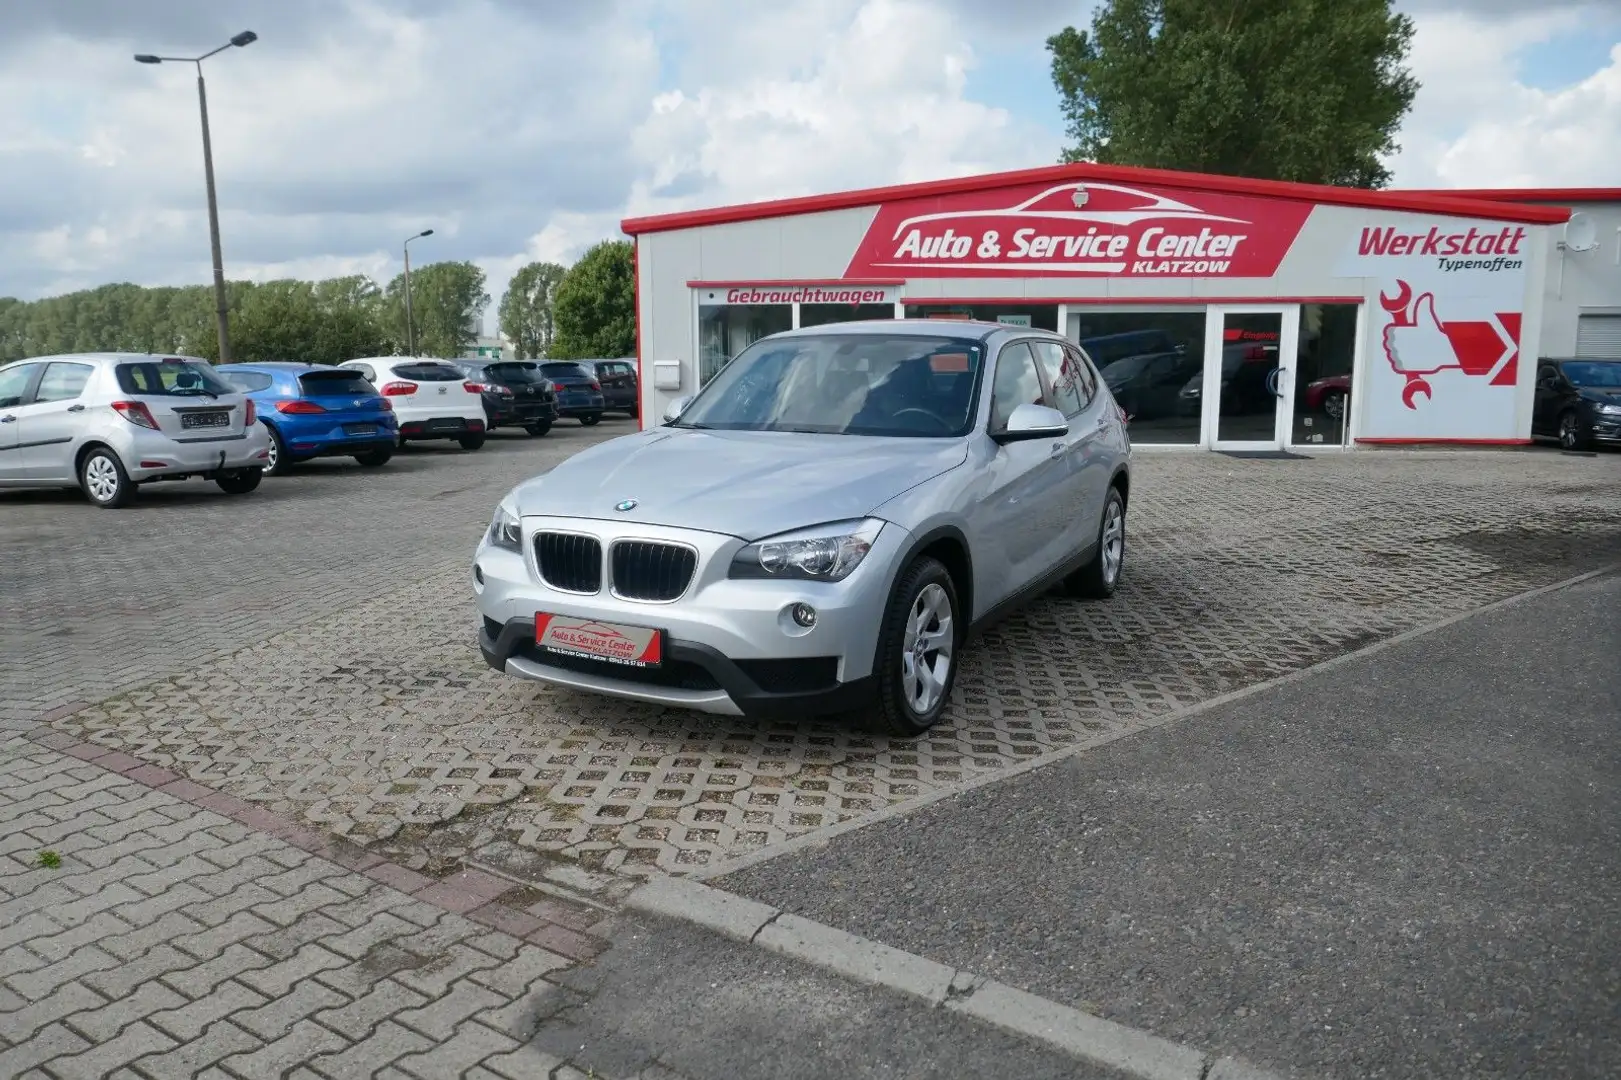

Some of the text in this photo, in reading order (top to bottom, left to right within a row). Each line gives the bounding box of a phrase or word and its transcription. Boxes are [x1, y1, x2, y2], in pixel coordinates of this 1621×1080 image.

[892, 226, 1247, 259] Auto & Service Center
[1358, 226, 1527, 256] Werkstatt
[1131, 260, 1232, 274] KLATZOW
[1438, 257, 1523, 272] Typenoffen
[727, 287, 885, 308] Gebrauchtwagen
[551, 630, 636, 651] Auto & Service Center
[593, 646, 633, 658] KLATZOW
